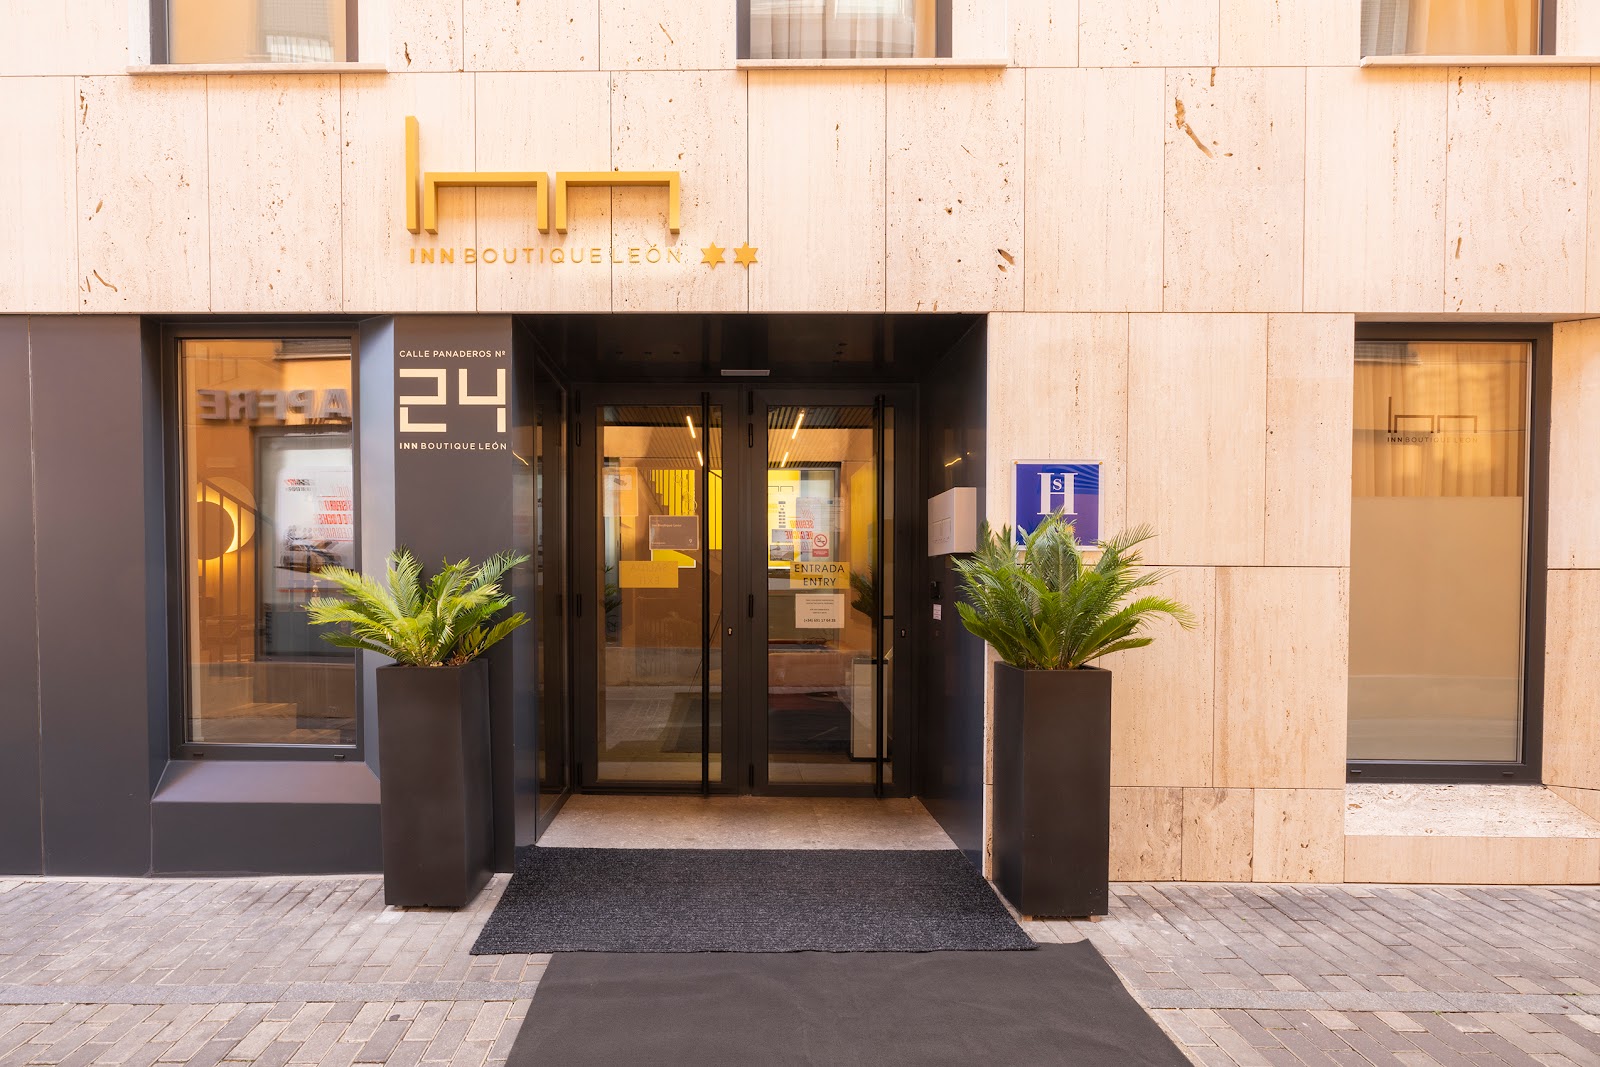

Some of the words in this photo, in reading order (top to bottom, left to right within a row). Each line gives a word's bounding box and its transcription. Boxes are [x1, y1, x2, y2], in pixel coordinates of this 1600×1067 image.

[410, 247, 455, 264] INN
[464, 247, 602, 264] BOUTIQUE
[612, 243, 681, 264] LEÓN
[399, 350, 430, 358] CALLE
[433, 350, 492, 358] PANADEROS
[399, 368, 506, 433] 24
[399, 442, 418, 450] INN
[420, 442, 476, 450] BOUTIQUE
[478, 441, 507, 450] LEÓN
[794, 564, 845, 573] ENTRADA
[803, 577, 836, 586] ENTRY
